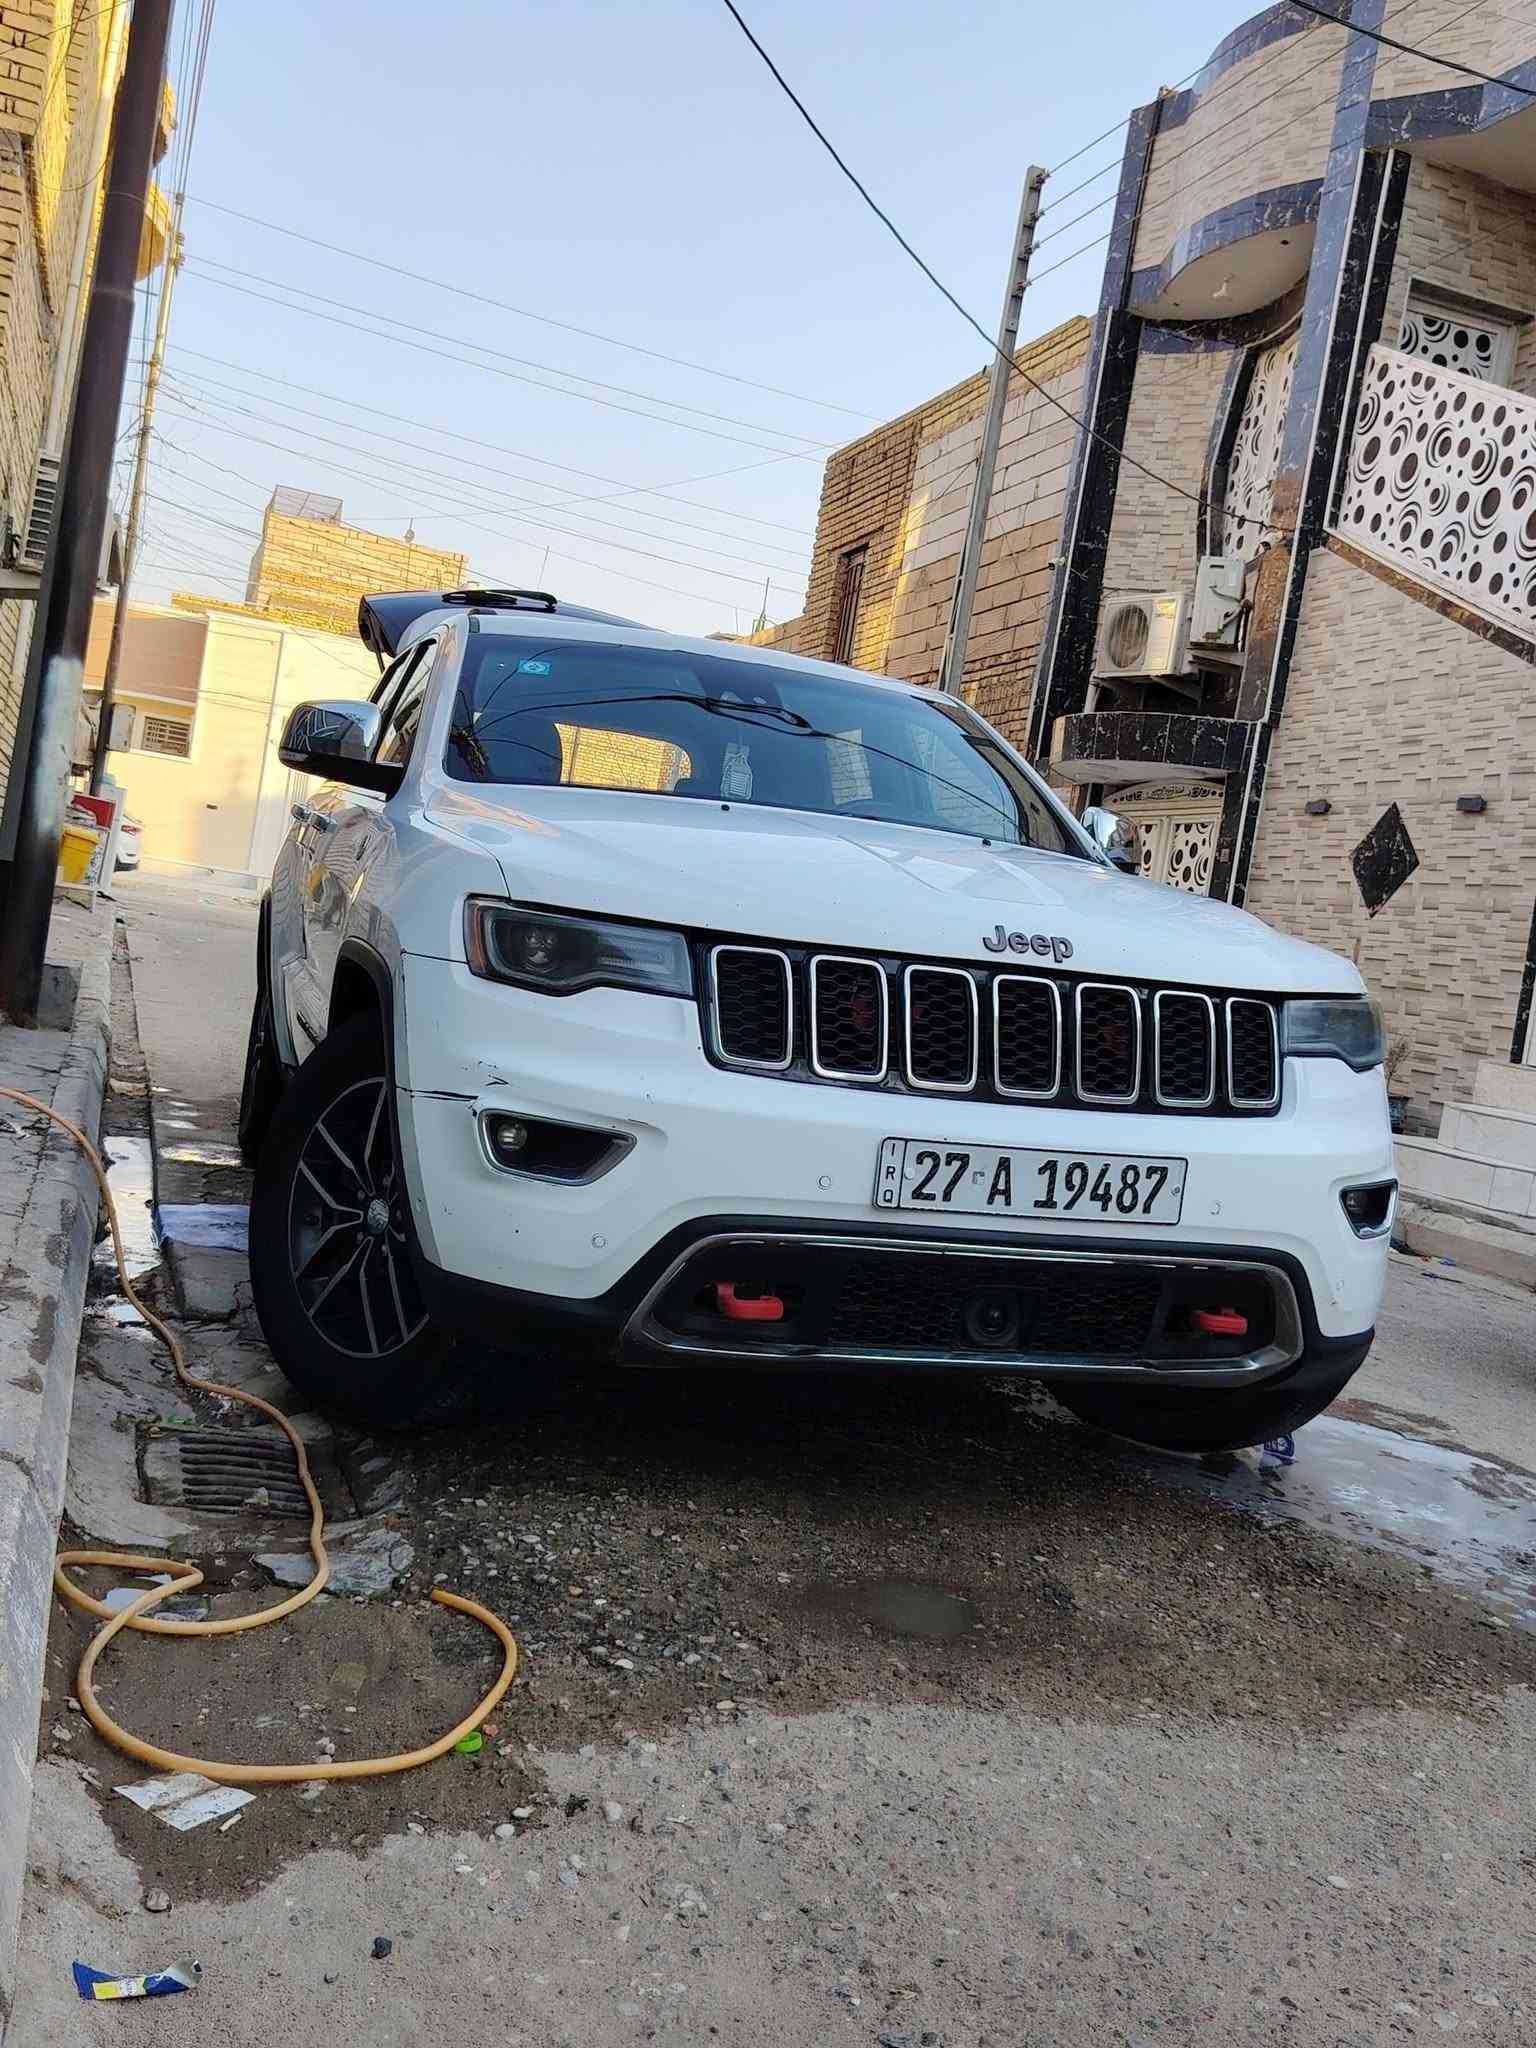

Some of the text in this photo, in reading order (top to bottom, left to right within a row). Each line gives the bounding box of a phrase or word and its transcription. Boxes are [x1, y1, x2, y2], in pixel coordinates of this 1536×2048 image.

[983, 925, 1074, 963] Jeep
[883, 1143, 896, 1203] IRQ
[911, 1150, 1169, 1214] 27 A 19487
